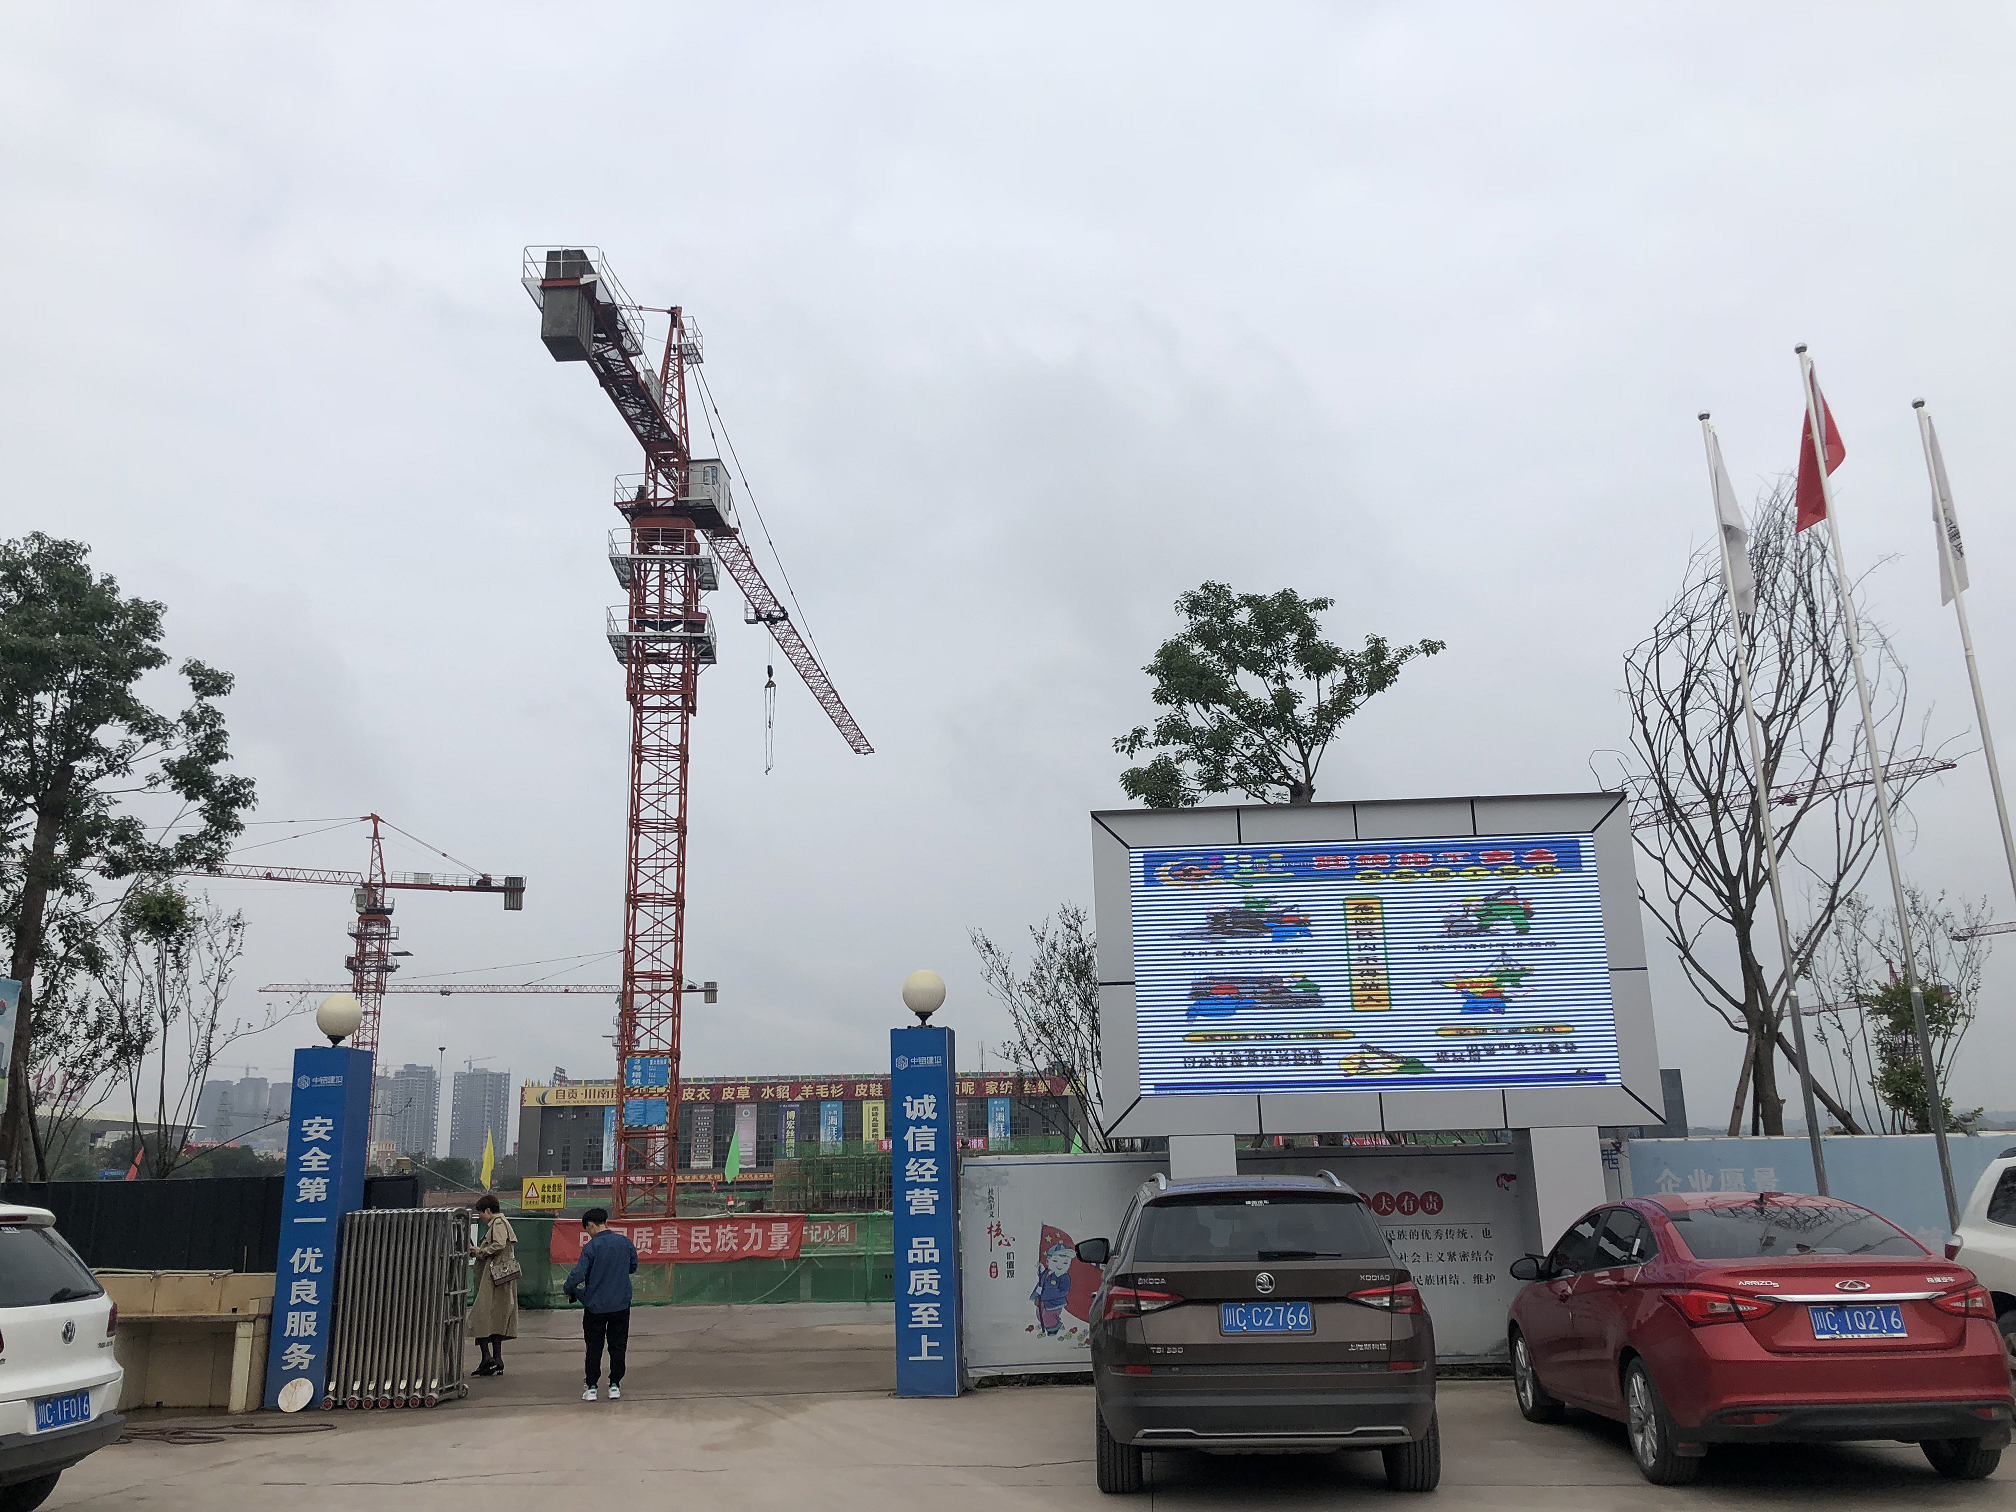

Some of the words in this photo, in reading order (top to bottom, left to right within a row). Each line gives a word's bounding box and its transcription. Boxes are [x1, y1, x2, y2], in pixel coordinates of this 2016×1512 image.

[682, 1087, 711, 1101] 皮衣
[721, 1086, 751, 1101] 皮草
[800, 1083, 844, 1099] 羊毛衫
[854, 1083, 884, 1098] 皮鞋
[985, 1080, 1014, 1095] 家纺
[293, 1115, 334, 1223] 安全第一
[903, 1094, 939, 1215] 诚信经营
[1655, 1167, 1779, 1193] 企业愿景
[1364, 1194, 1439, 1212] 夫有责
[690, 1222, 791, 1254] 民族力量
[1006, 1252, 1015, 1279] 价值观
[1400, 1250, 1494, 1263] 社会主义紧密结合
[281, 1246, 324, 1371] 优良服务
[907, 1236, 944, 1361] 品质至上
